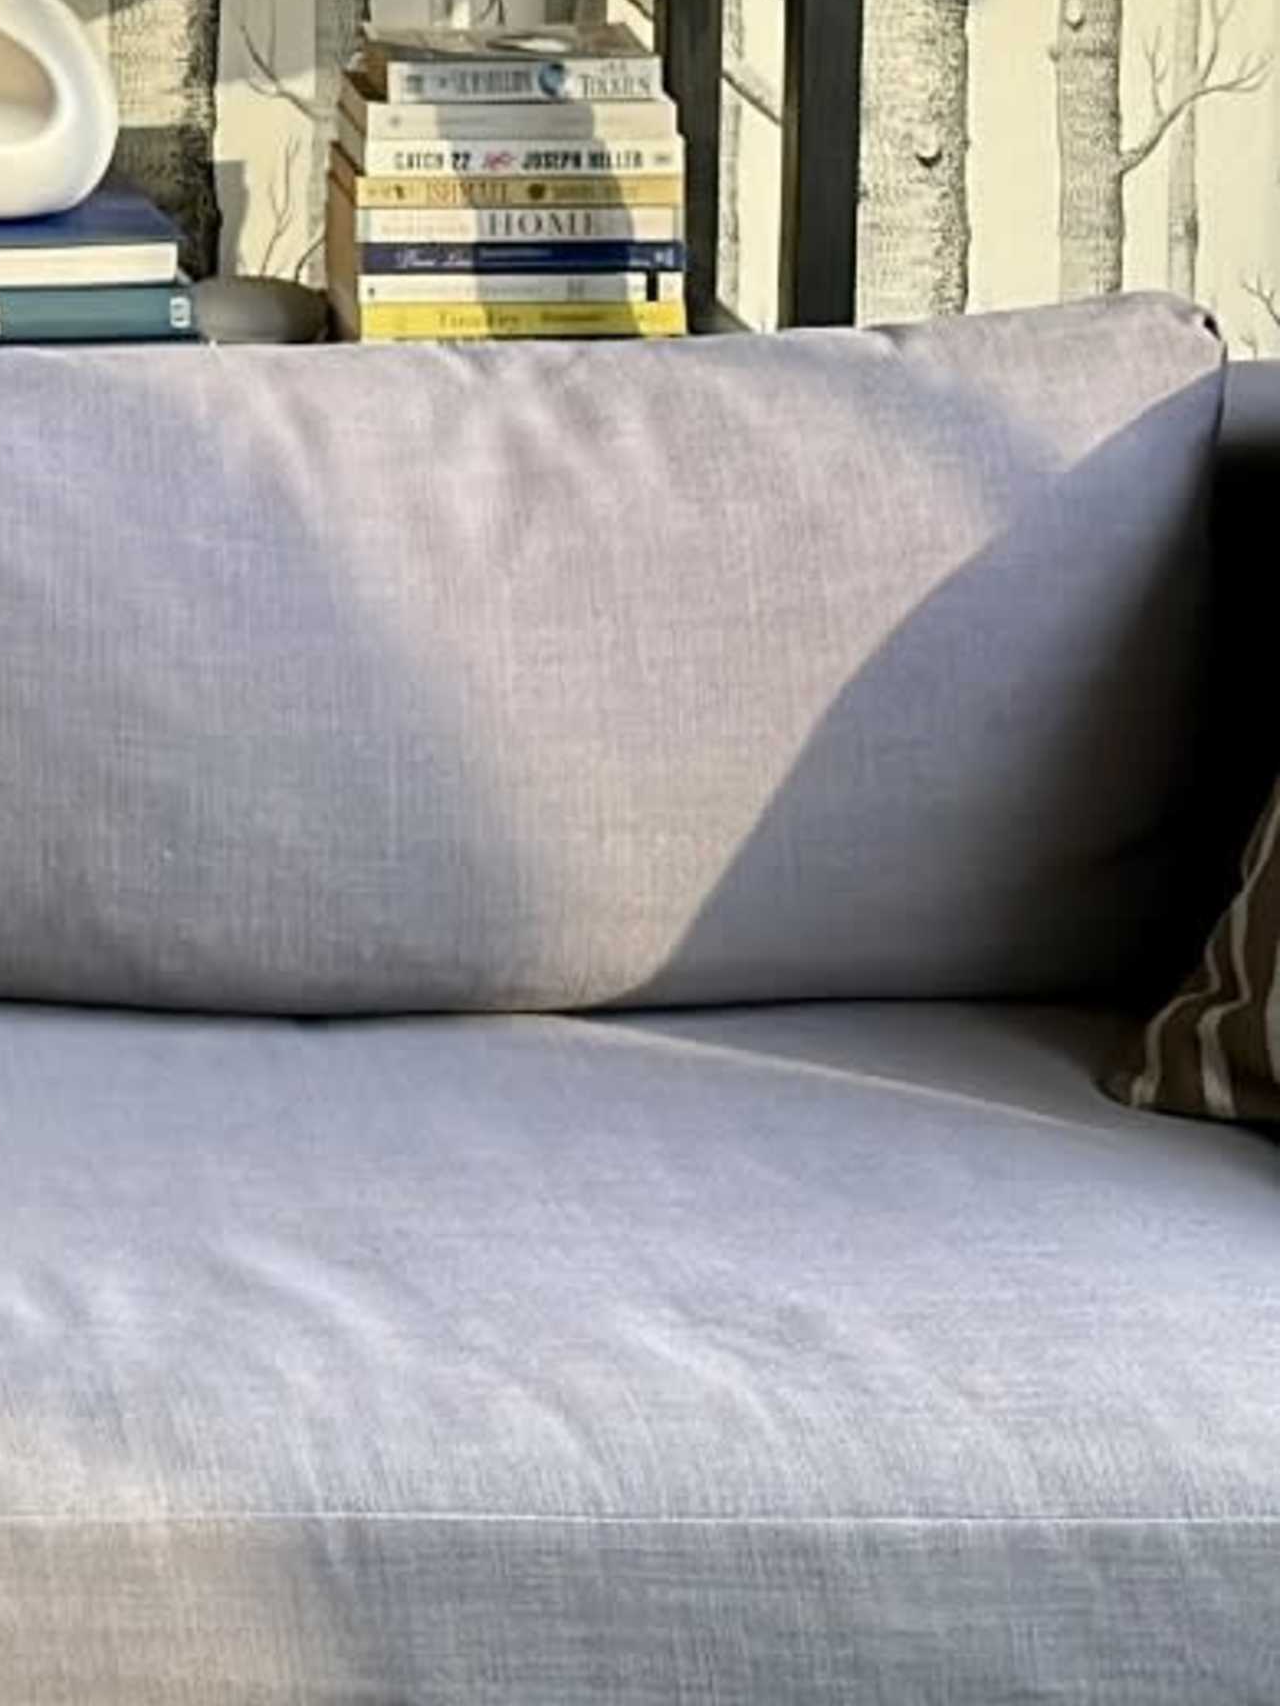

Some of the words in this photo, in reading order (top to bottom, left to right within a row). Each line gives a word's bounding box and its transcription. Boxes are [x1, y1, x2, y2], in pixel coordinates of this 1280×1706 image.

[522, 150, 582, 169] JOSEPH
[587, 150, 644, 168] HELLER
[490, 212, 594, 236] HOME
